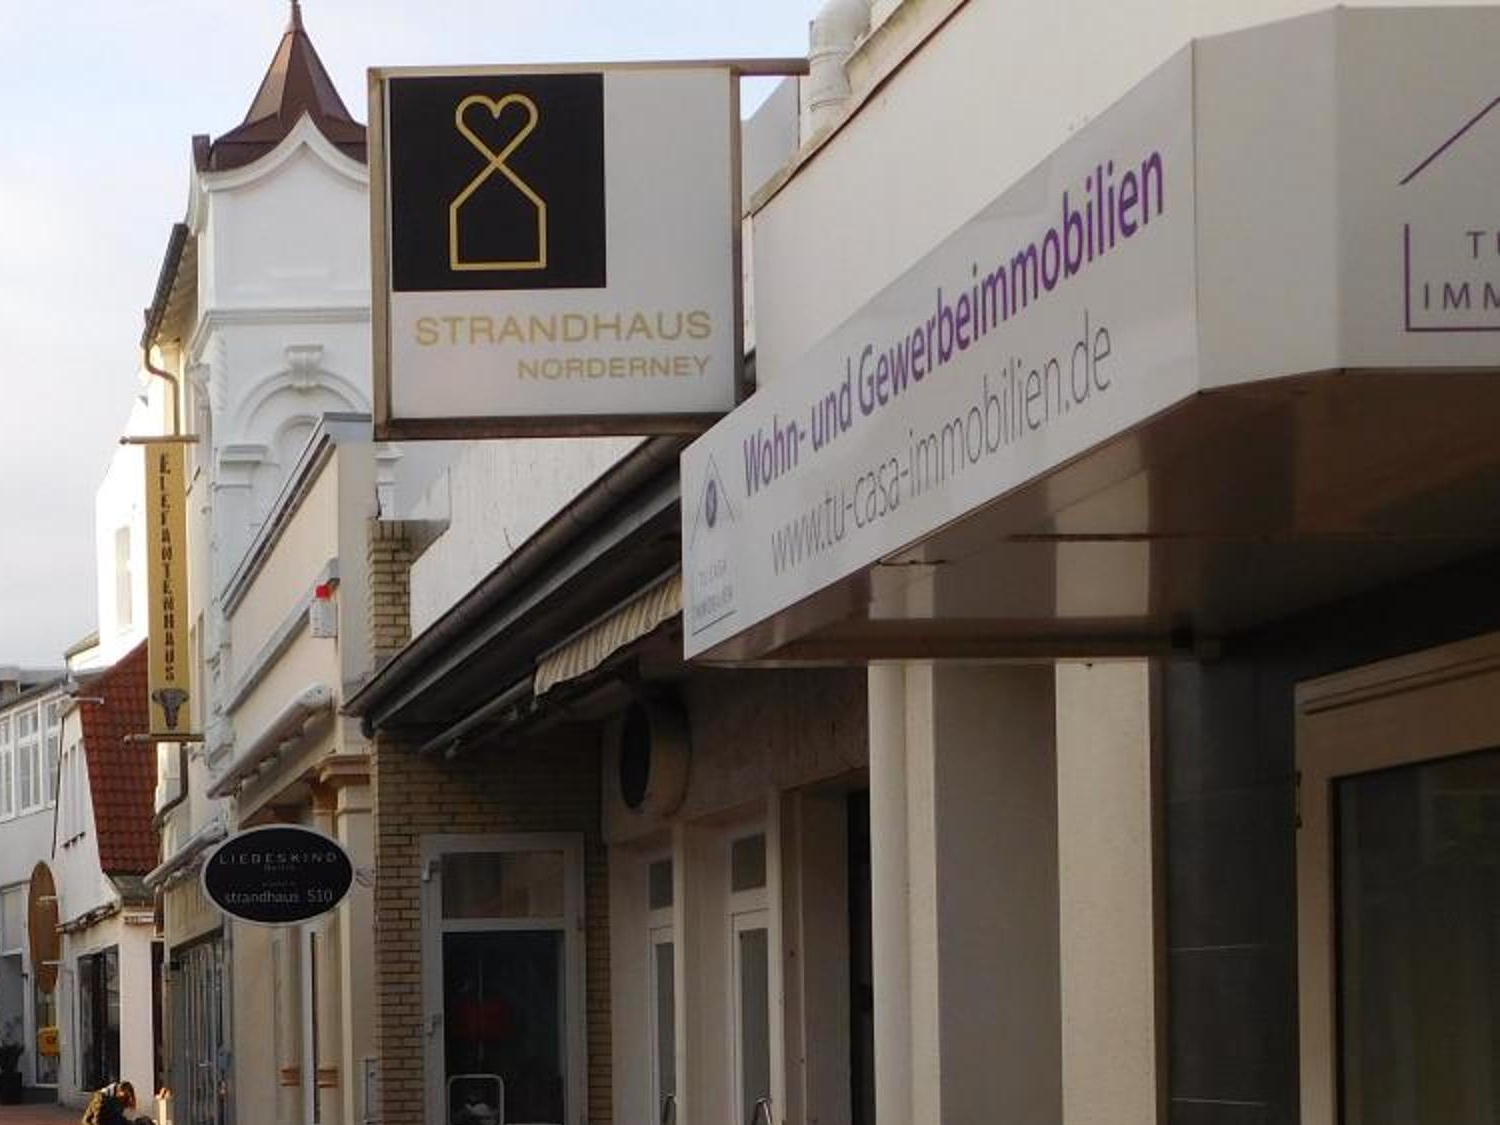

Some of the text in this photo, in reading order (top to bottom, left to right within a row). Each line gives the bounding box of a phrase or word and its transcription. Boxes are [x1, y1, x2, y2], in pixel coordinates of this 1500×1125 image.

[1465, 230, 1500, 260] T
[414, 310, 713, 347] STRANDHAUS
[742, 150, 1164, 497] Wohn- und Gewerbeimmobilien
[516, 354, 709, 381] NORDERNEY
[770, 308, 1112, 576] www.tu-casa-immobilien.de
[158, 452, 176, 682] ELEFANTENHAUS
[219, 852, 338, 865] LIEBESKIND
[226, 888, 301, 904] strandhaus
